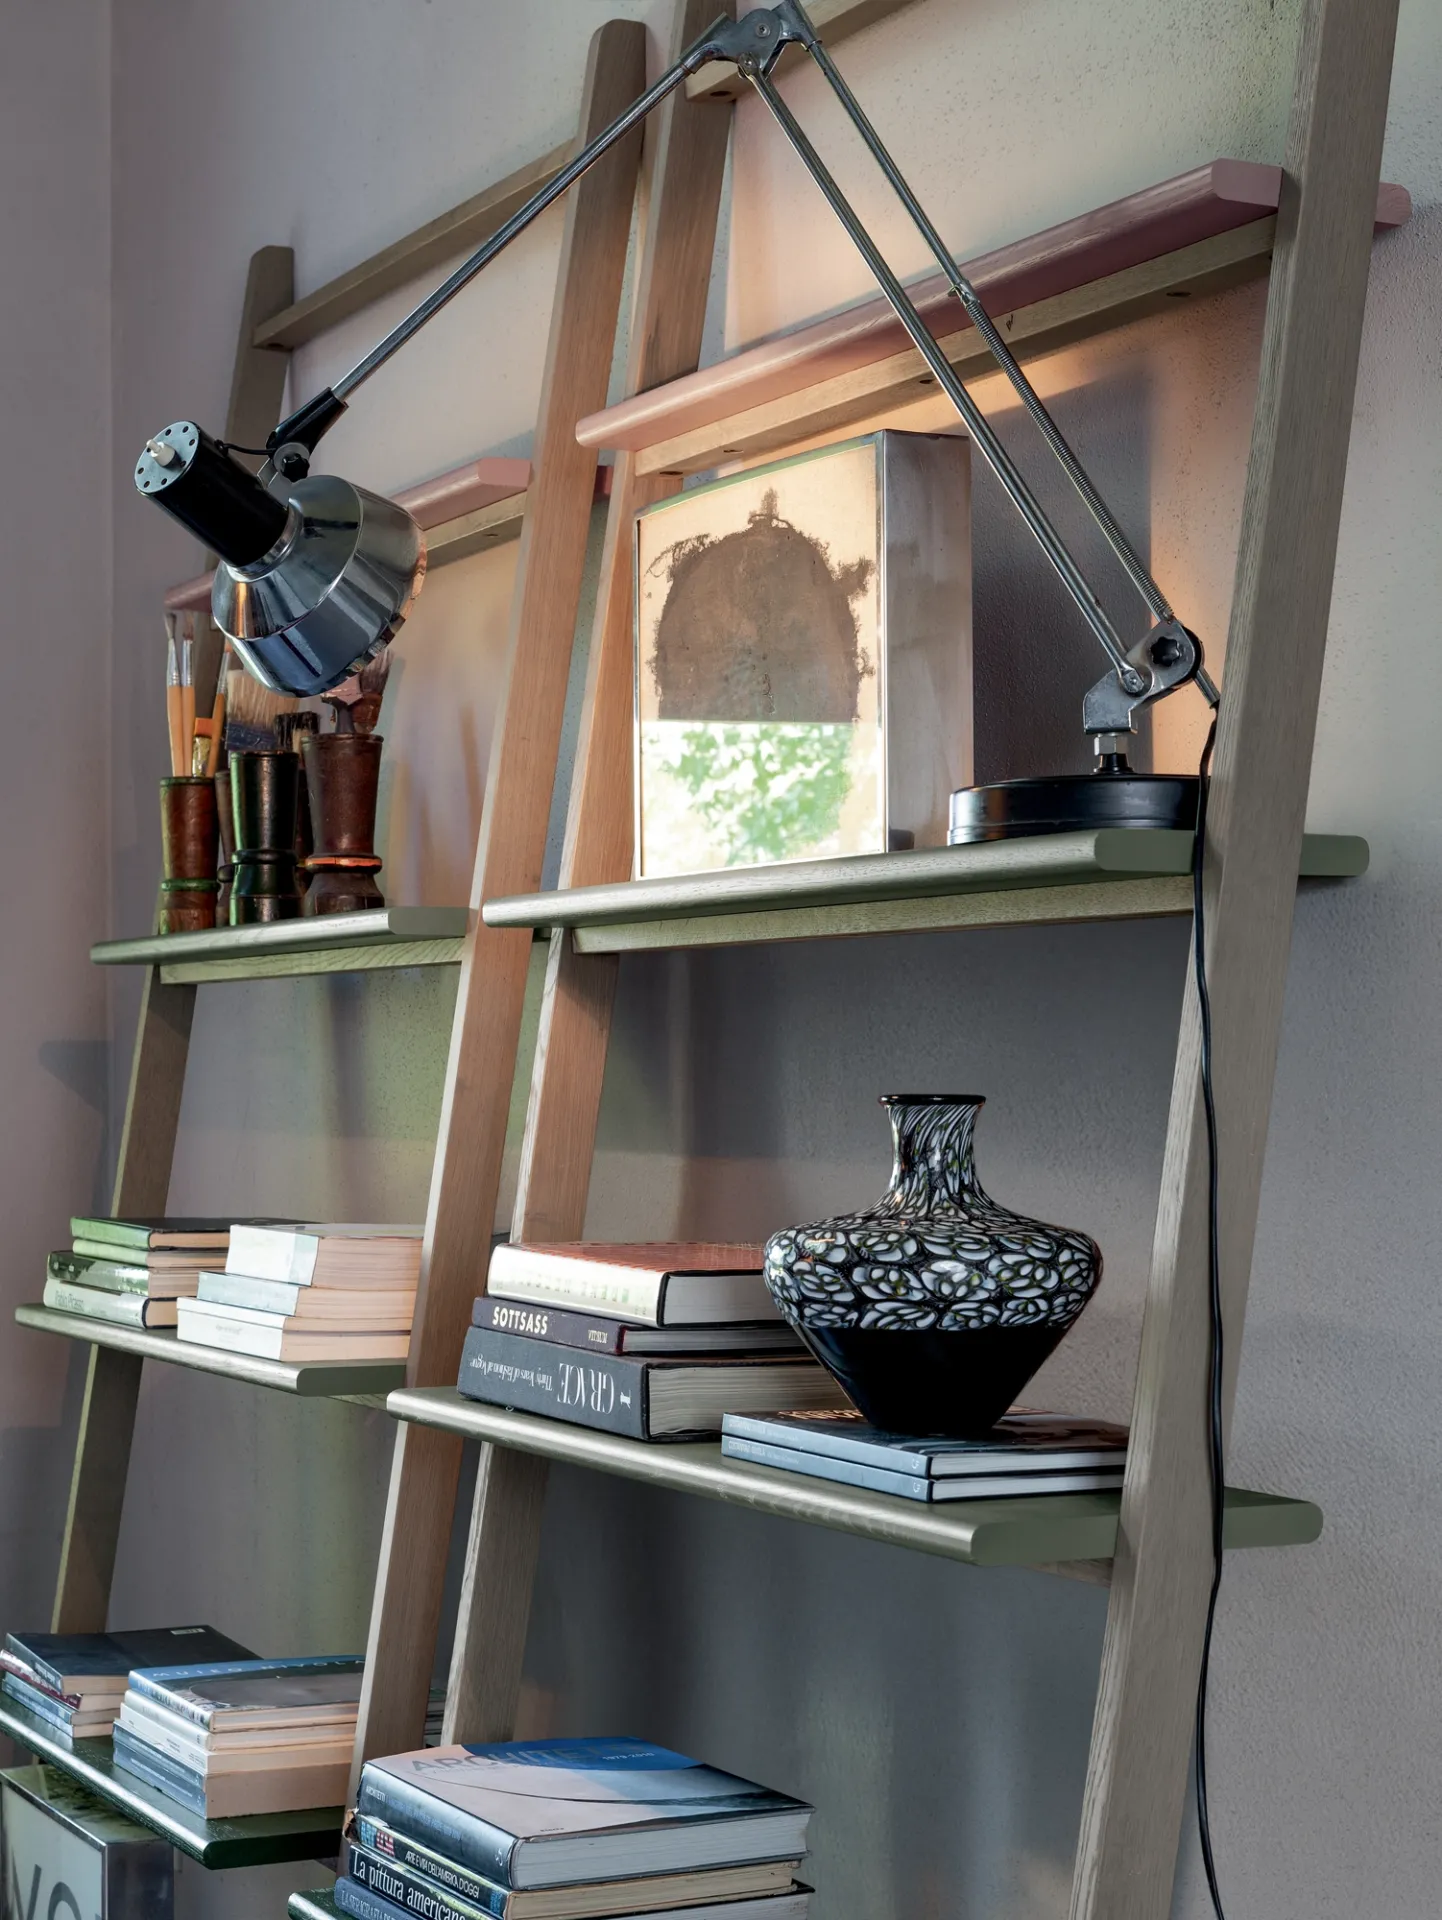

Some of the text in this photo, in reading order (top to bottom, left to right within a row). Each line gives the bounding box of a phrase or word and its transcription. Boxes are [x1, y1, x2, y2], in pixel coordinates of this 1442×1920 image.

[492, 1306, 549, 1335] SOTTSASS
[557, 1363, 615, 1415] GRACE
[352, 1851, 366, 1879] La
[369, 1865, 404, 1901] pittura
